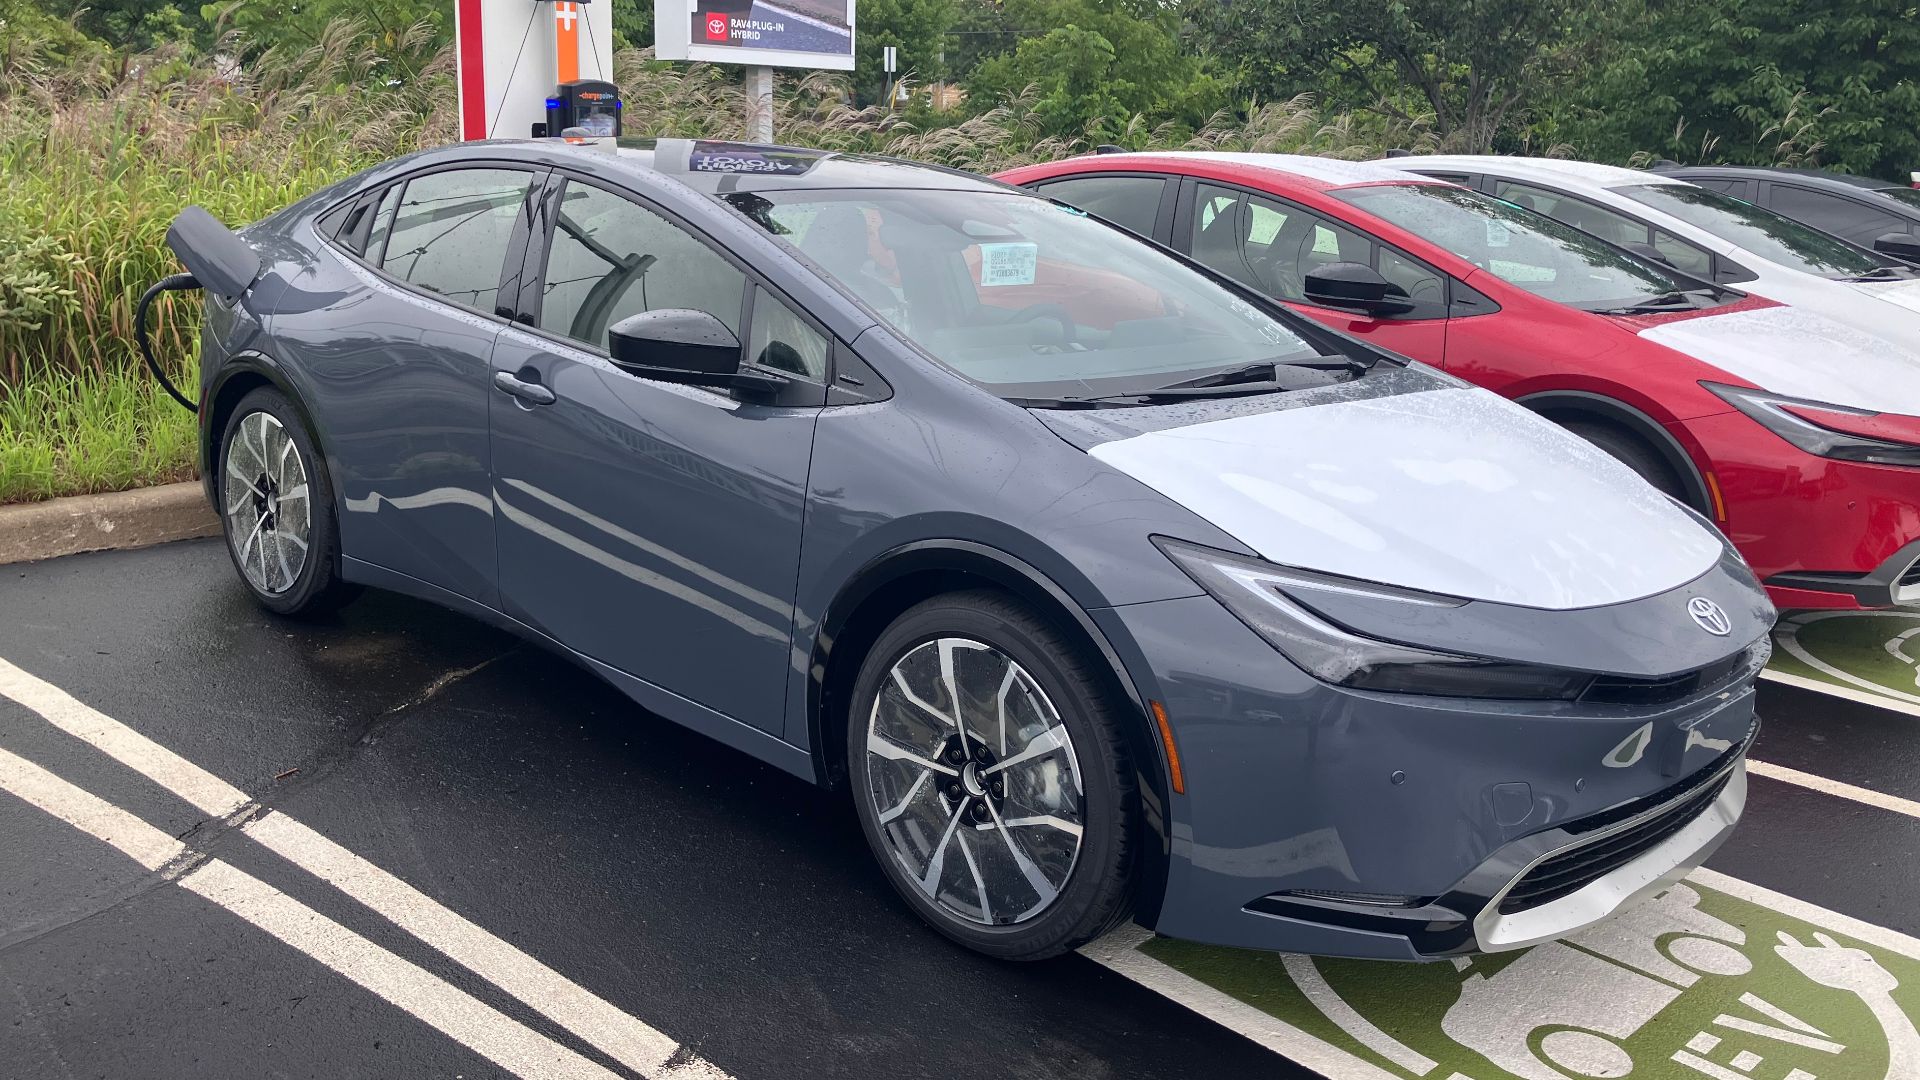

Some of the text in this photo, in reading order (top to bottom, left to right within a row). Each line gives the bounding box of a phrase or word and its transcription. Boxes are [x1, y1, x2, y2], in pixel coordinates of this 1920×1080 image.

[730, 18, 784, 33] RAV4 PLUG-IN
[730, 29, 761, 40] HYBRID
[1670, 991, 1847, 1080] EV
